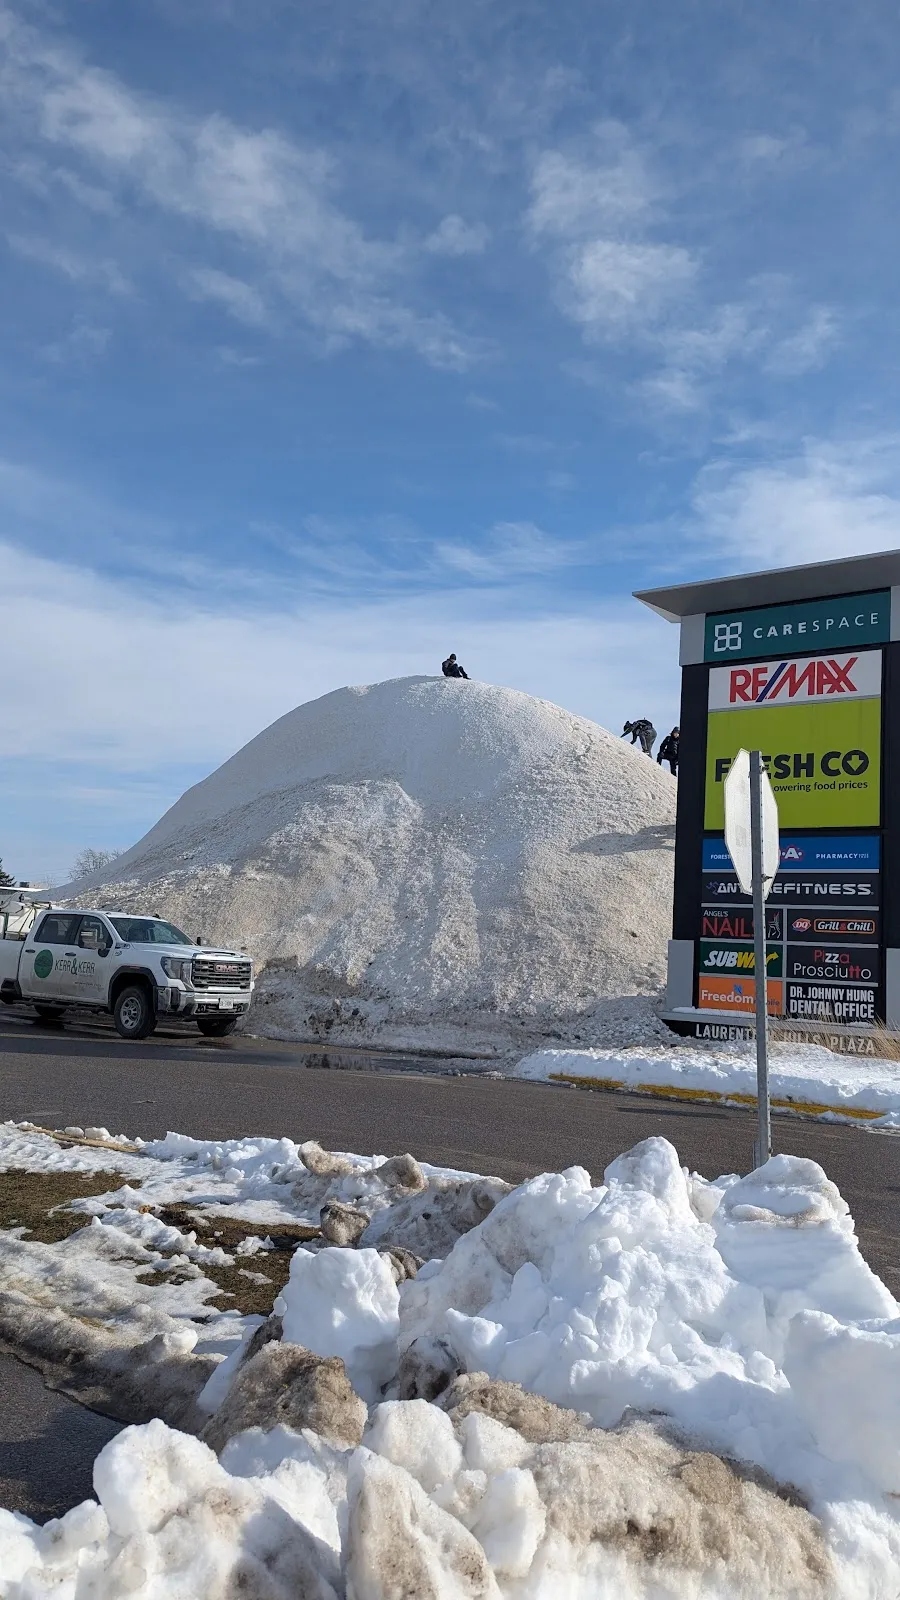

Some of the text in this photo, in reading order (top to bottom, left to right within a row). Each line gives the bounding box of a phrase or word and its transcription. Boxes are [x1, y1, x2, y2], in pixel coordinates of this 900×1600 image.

[753, 612, 879, 639] CARESPACE
[729, 657, 858, 703] RE/MAX
[715, 752, 815, 783] FSH
[773, 781, 868, 792] owering food prices
[702, 917, 755, 938] NAIL
[795, 921, 808, 929] DQ
[814, 949, 850, 964] Pizza
[793, 962, 872, 980] Prosciutto
[701, 989, 754, 1004] Freedom
[790, 985, 874, 1003] DR. JOHNNY HUNG
[790, 998, 875, 1019] DENTAL OFFICE
[830, 1036, 875, 1054] PLAZA
